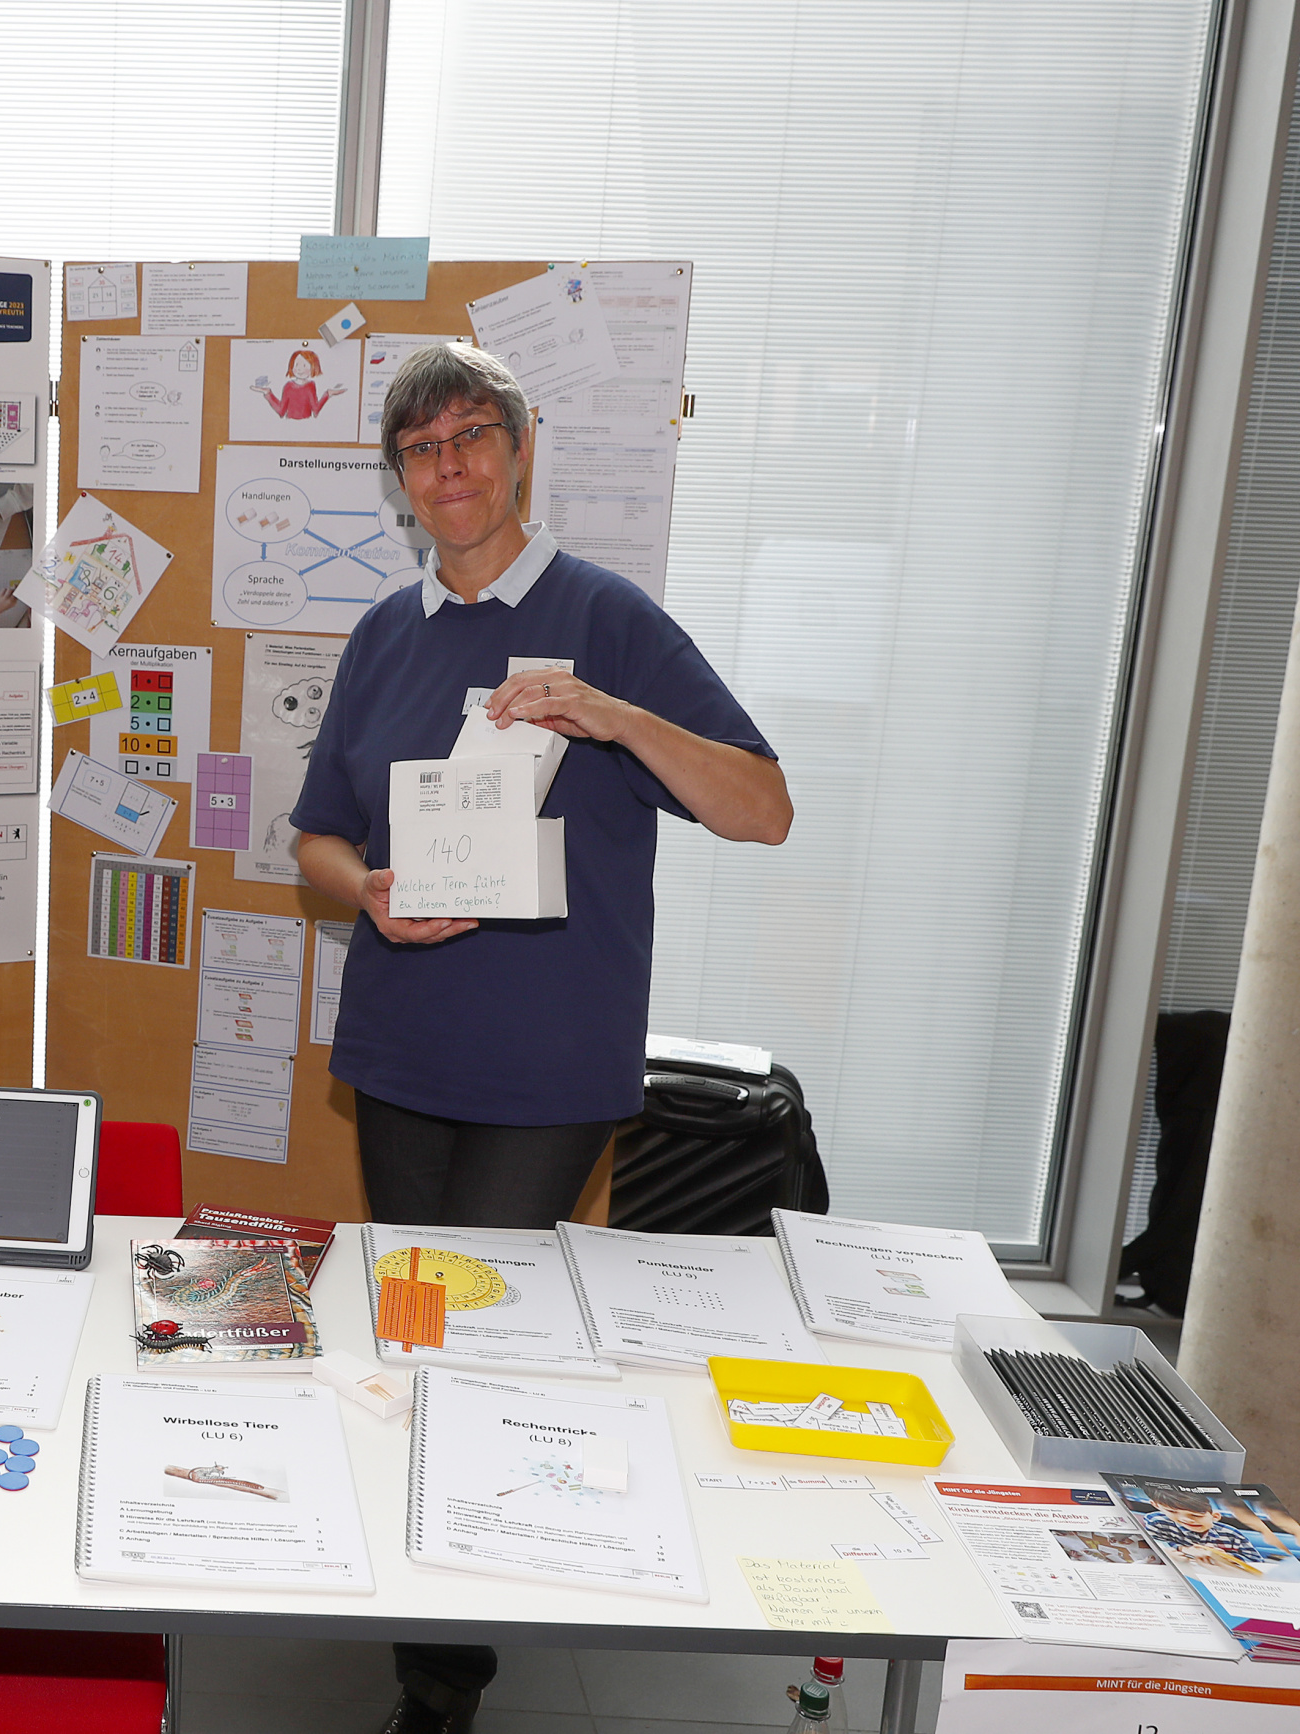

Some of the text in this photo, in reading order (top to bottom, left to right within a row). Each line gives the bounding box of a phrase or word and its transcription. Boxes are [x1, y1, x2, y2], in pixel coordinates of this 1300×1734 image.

[242, 492, 290, 501] Handlungen
[248, 574, 284, 585] Sprache
[109, 645, 197, 661] Kernaufgaben
[426, 835, 472, 864] 140
[396, 875, 506, 893] Welcher Term führt
[399, 901, 411, 909] zu
[418, 896, 447, 909] diesem
[200, 1208, 285, 1224] PraxisRatgeber
[198, 1214, 299, 1234] Tausendfüßer
[816, 1238, 963, 1261] Rechnungen verstecken
[637, 1258, 715, 1274] Punktebilder
[163, 1416, 279, 1430] Wirbellose Tiere
[502, 1418, 597, 1437] Rechentricks
[201, 1431, 244, 1442] (LU 6)
[529, 1434, 572, 1447] (LU 8)
[987, 1489, 1021, 1497] Jüngsten
[742, 1558, 842, 1570] Das Material
[752, 1573, 846, 1585] ist kostenlos
[756, 1583, 852, 1594] als Download
[769, 1605, 814, 1614] Nehmen
[821, 1606, 838, 1614] Sie
[774, 1614, 833, 1627] Flyer mit
[1096, 1679, 1212, 1695] MINT für die Jüngsten
